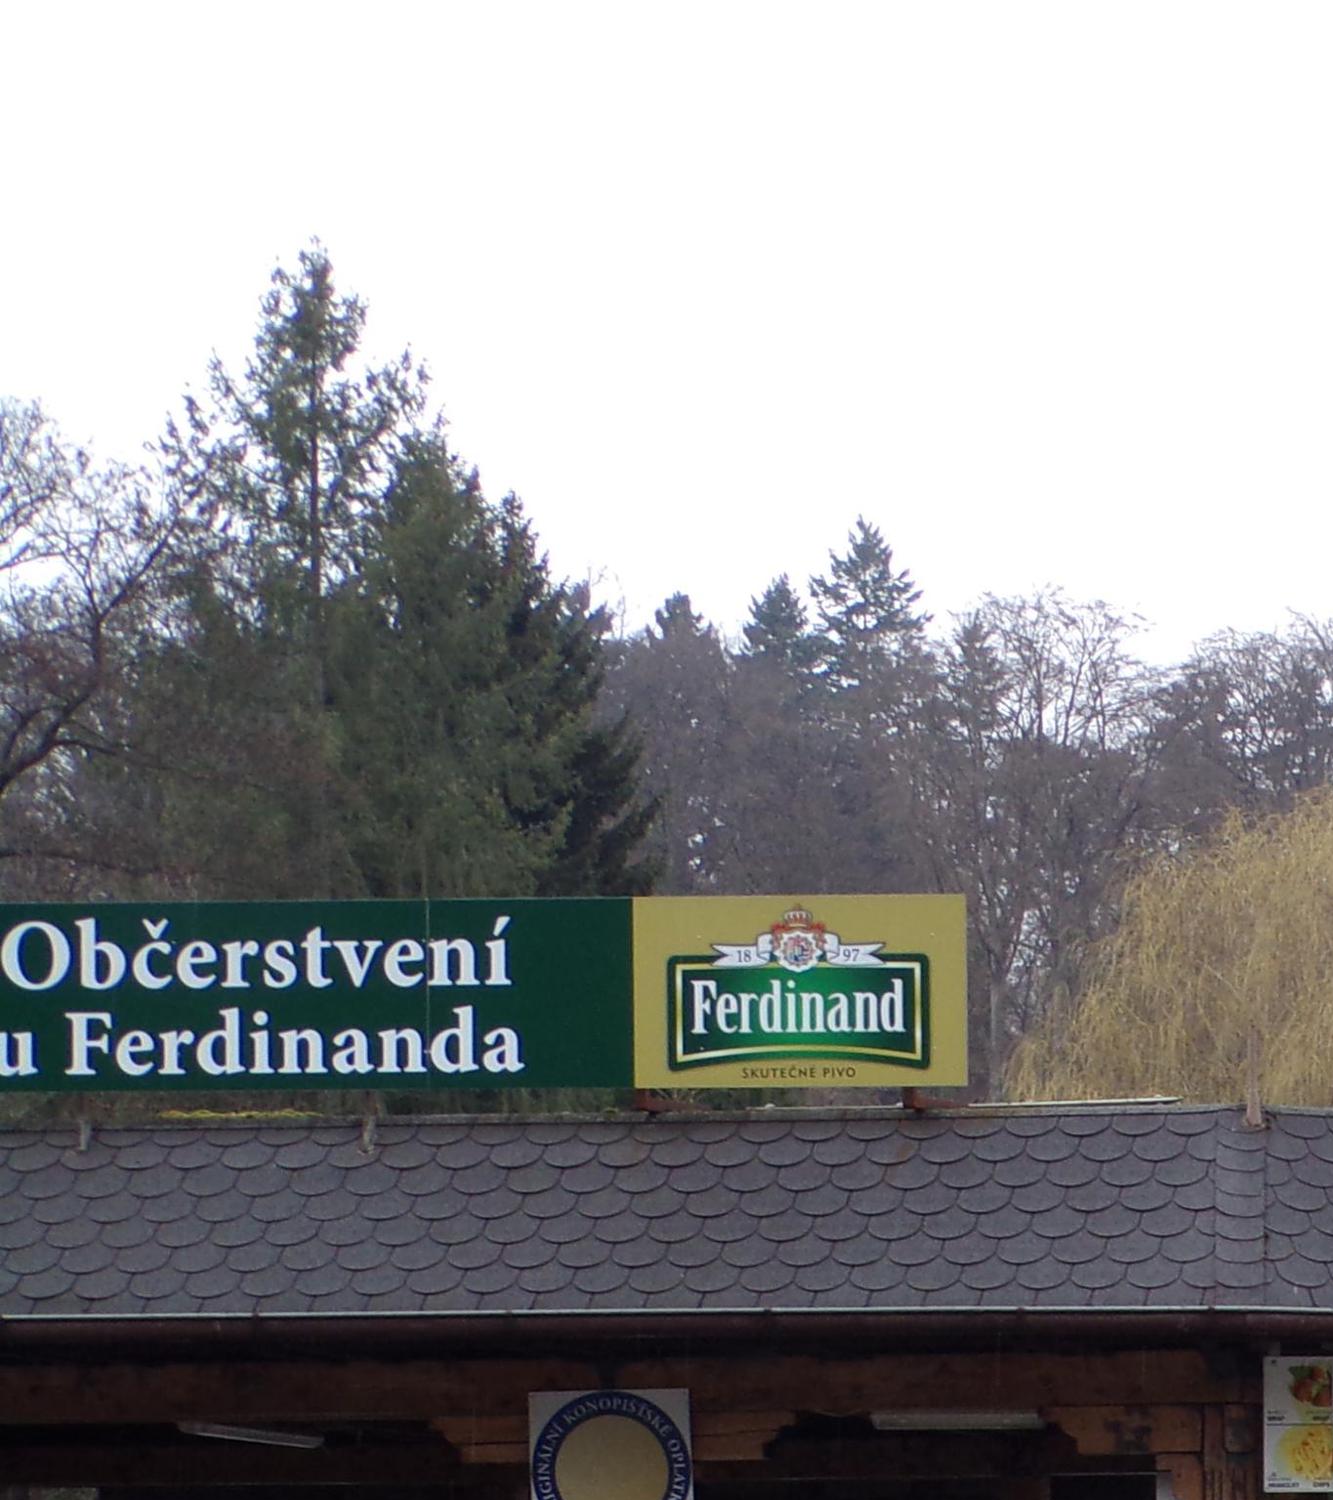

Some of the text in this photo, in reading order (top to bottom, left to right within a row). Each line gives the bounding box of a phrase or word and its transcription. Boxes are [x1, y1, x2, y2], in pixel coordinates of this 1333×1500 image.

[1, 916, 513, 991] Občerstvení
[737, 949, 860, 963] 18 97
[690, 978, 908, 1035] Ferdinand
[0, 1005, 526, 1076] u Ferdinanda
[823, 1066, 856, 1079] PIVO
